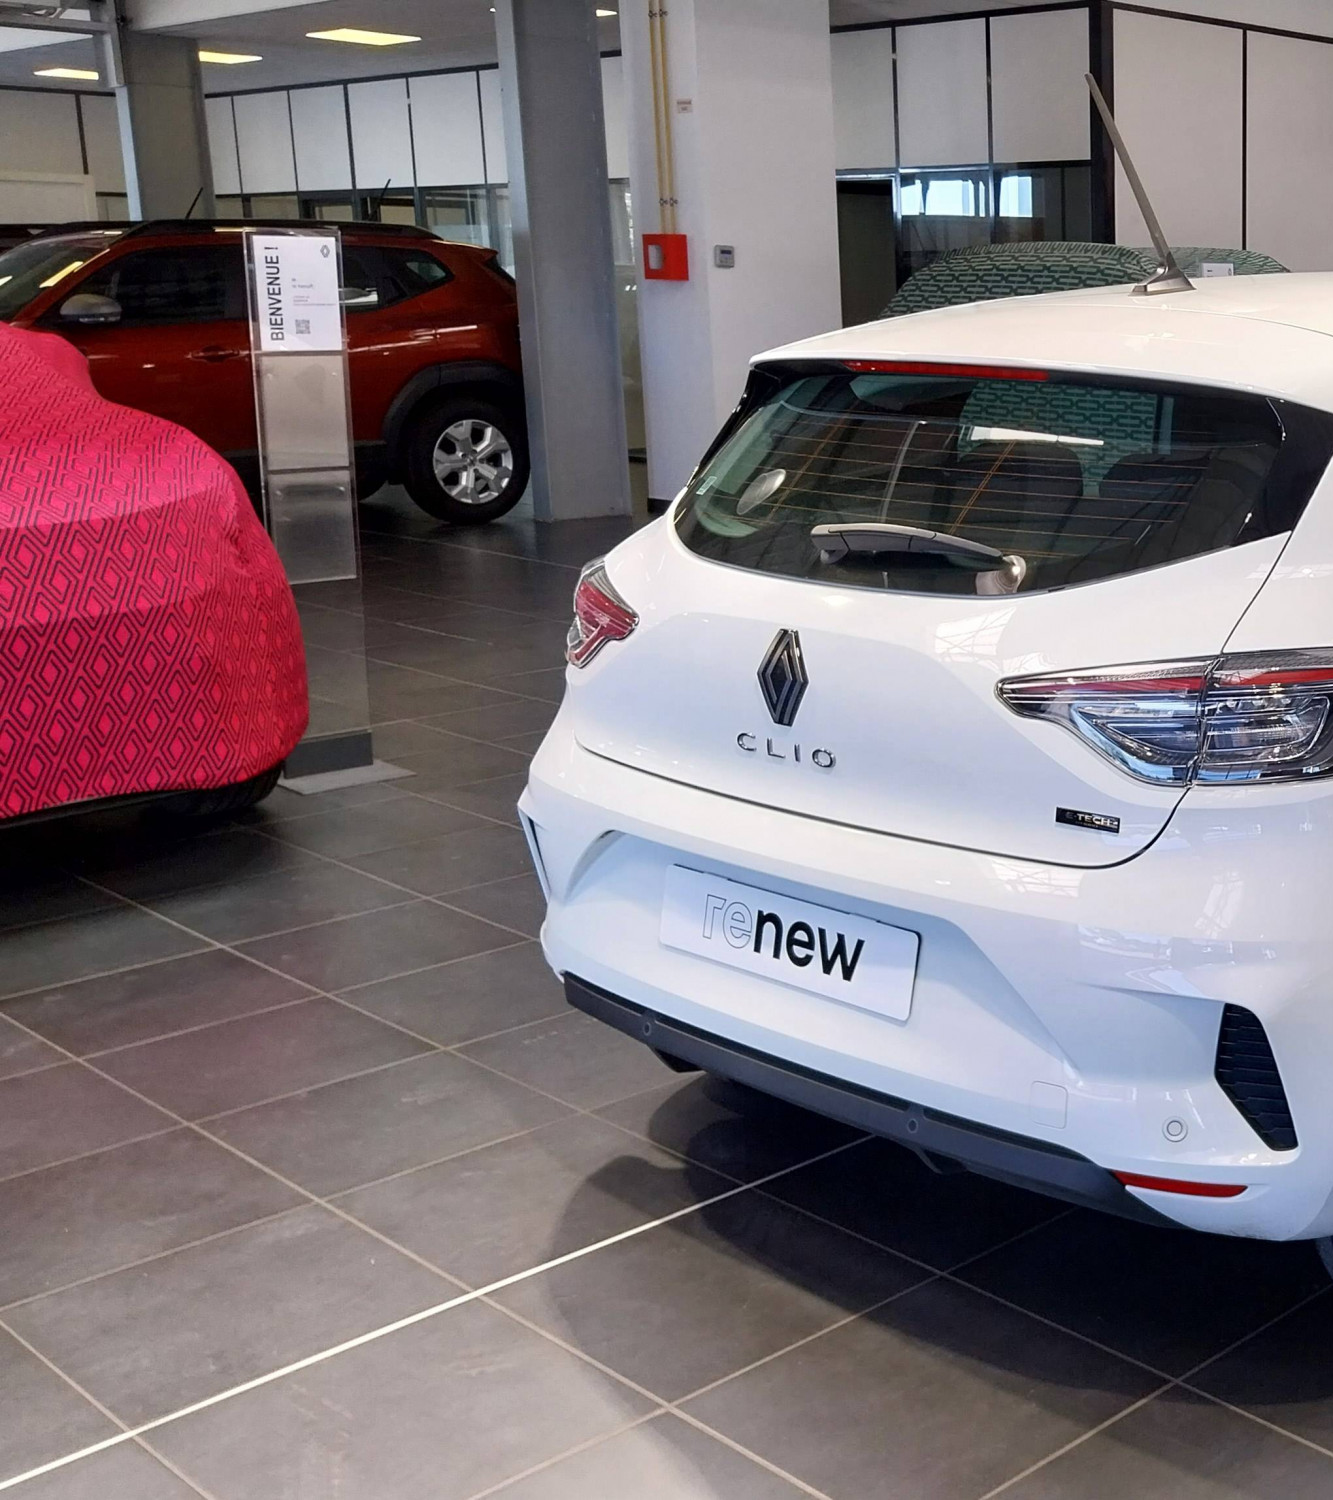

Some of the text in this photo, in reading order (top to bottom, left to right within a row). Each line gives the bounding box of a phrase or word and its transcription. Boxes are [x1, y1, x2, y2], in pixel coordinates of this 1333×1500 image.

[264, 255, 285, 341] BIENVENUE
[736, 732, 837, 769] CLIO
[702, 893, 866, 983] renew
